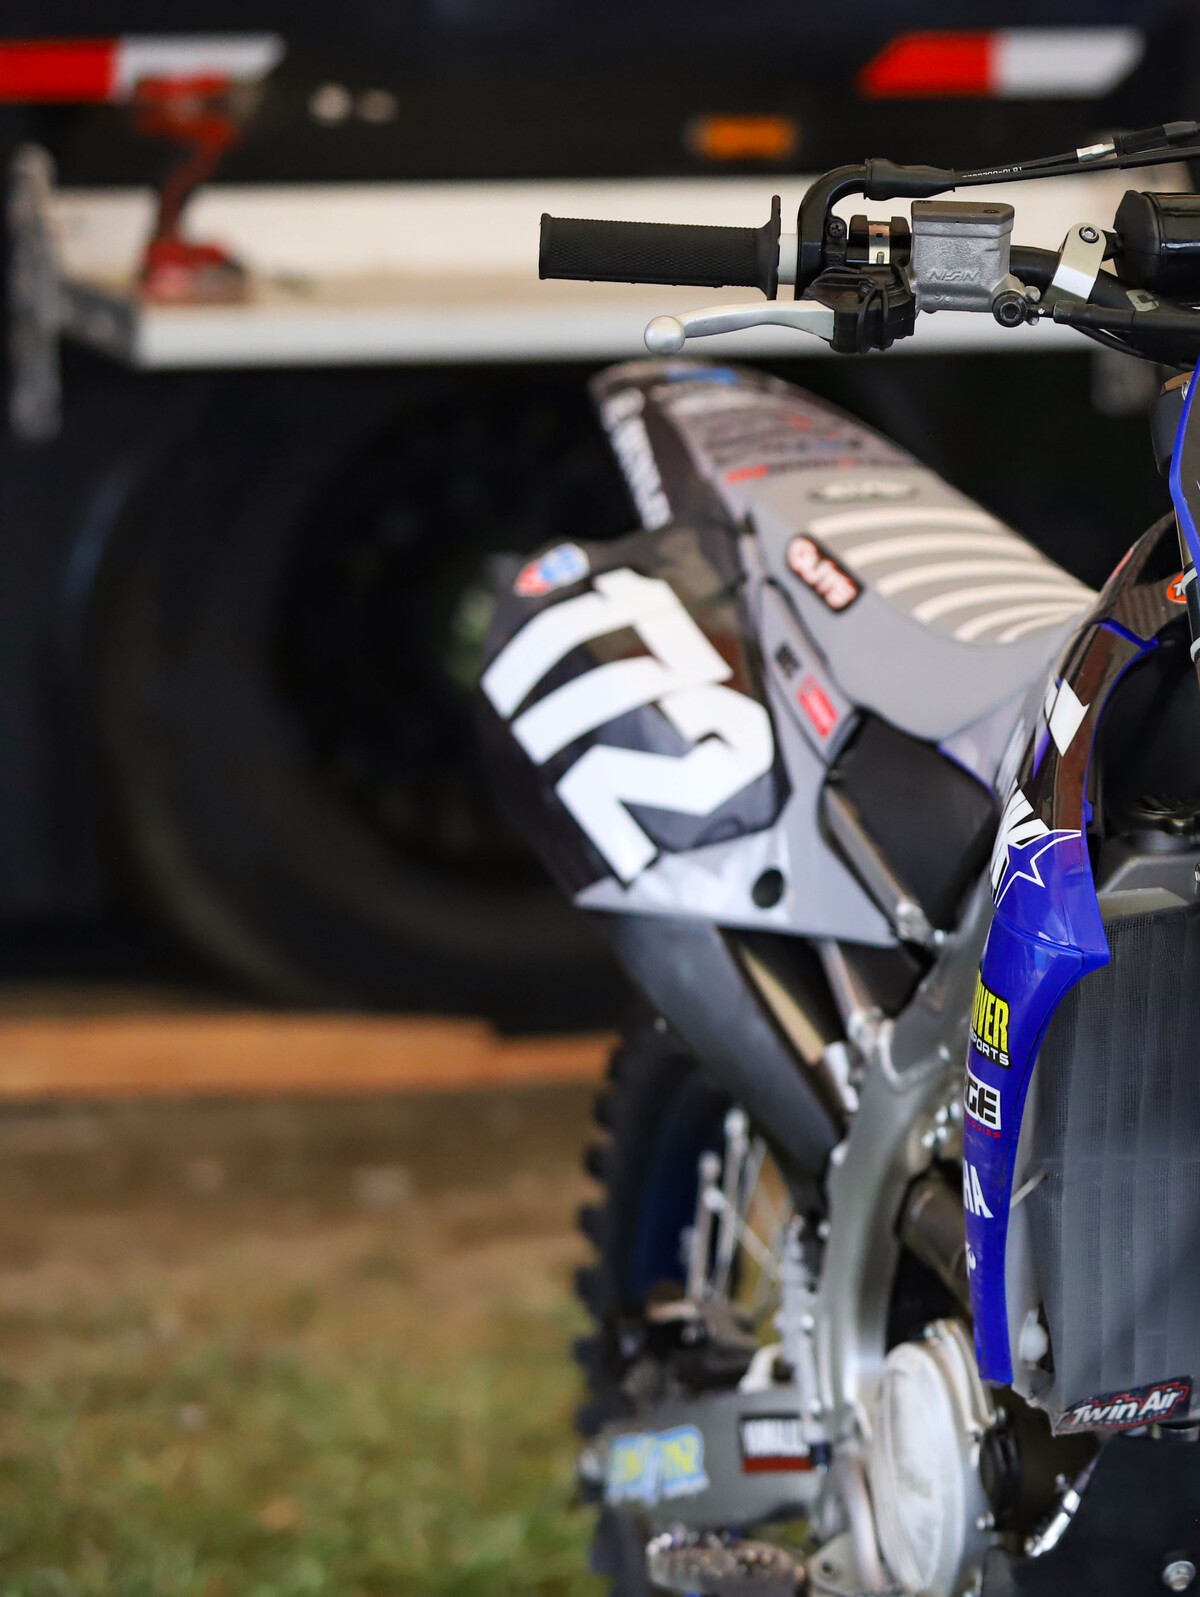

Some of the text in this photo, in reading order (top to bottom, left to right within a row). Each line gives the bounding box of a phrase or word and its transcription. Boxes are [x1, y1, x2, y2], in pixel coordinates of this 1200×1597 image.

[480, 567, 774, 885] 172
[1071, 1399, 1139, 1425] Twin
[1139, 1387, 1184, 1416] Air
